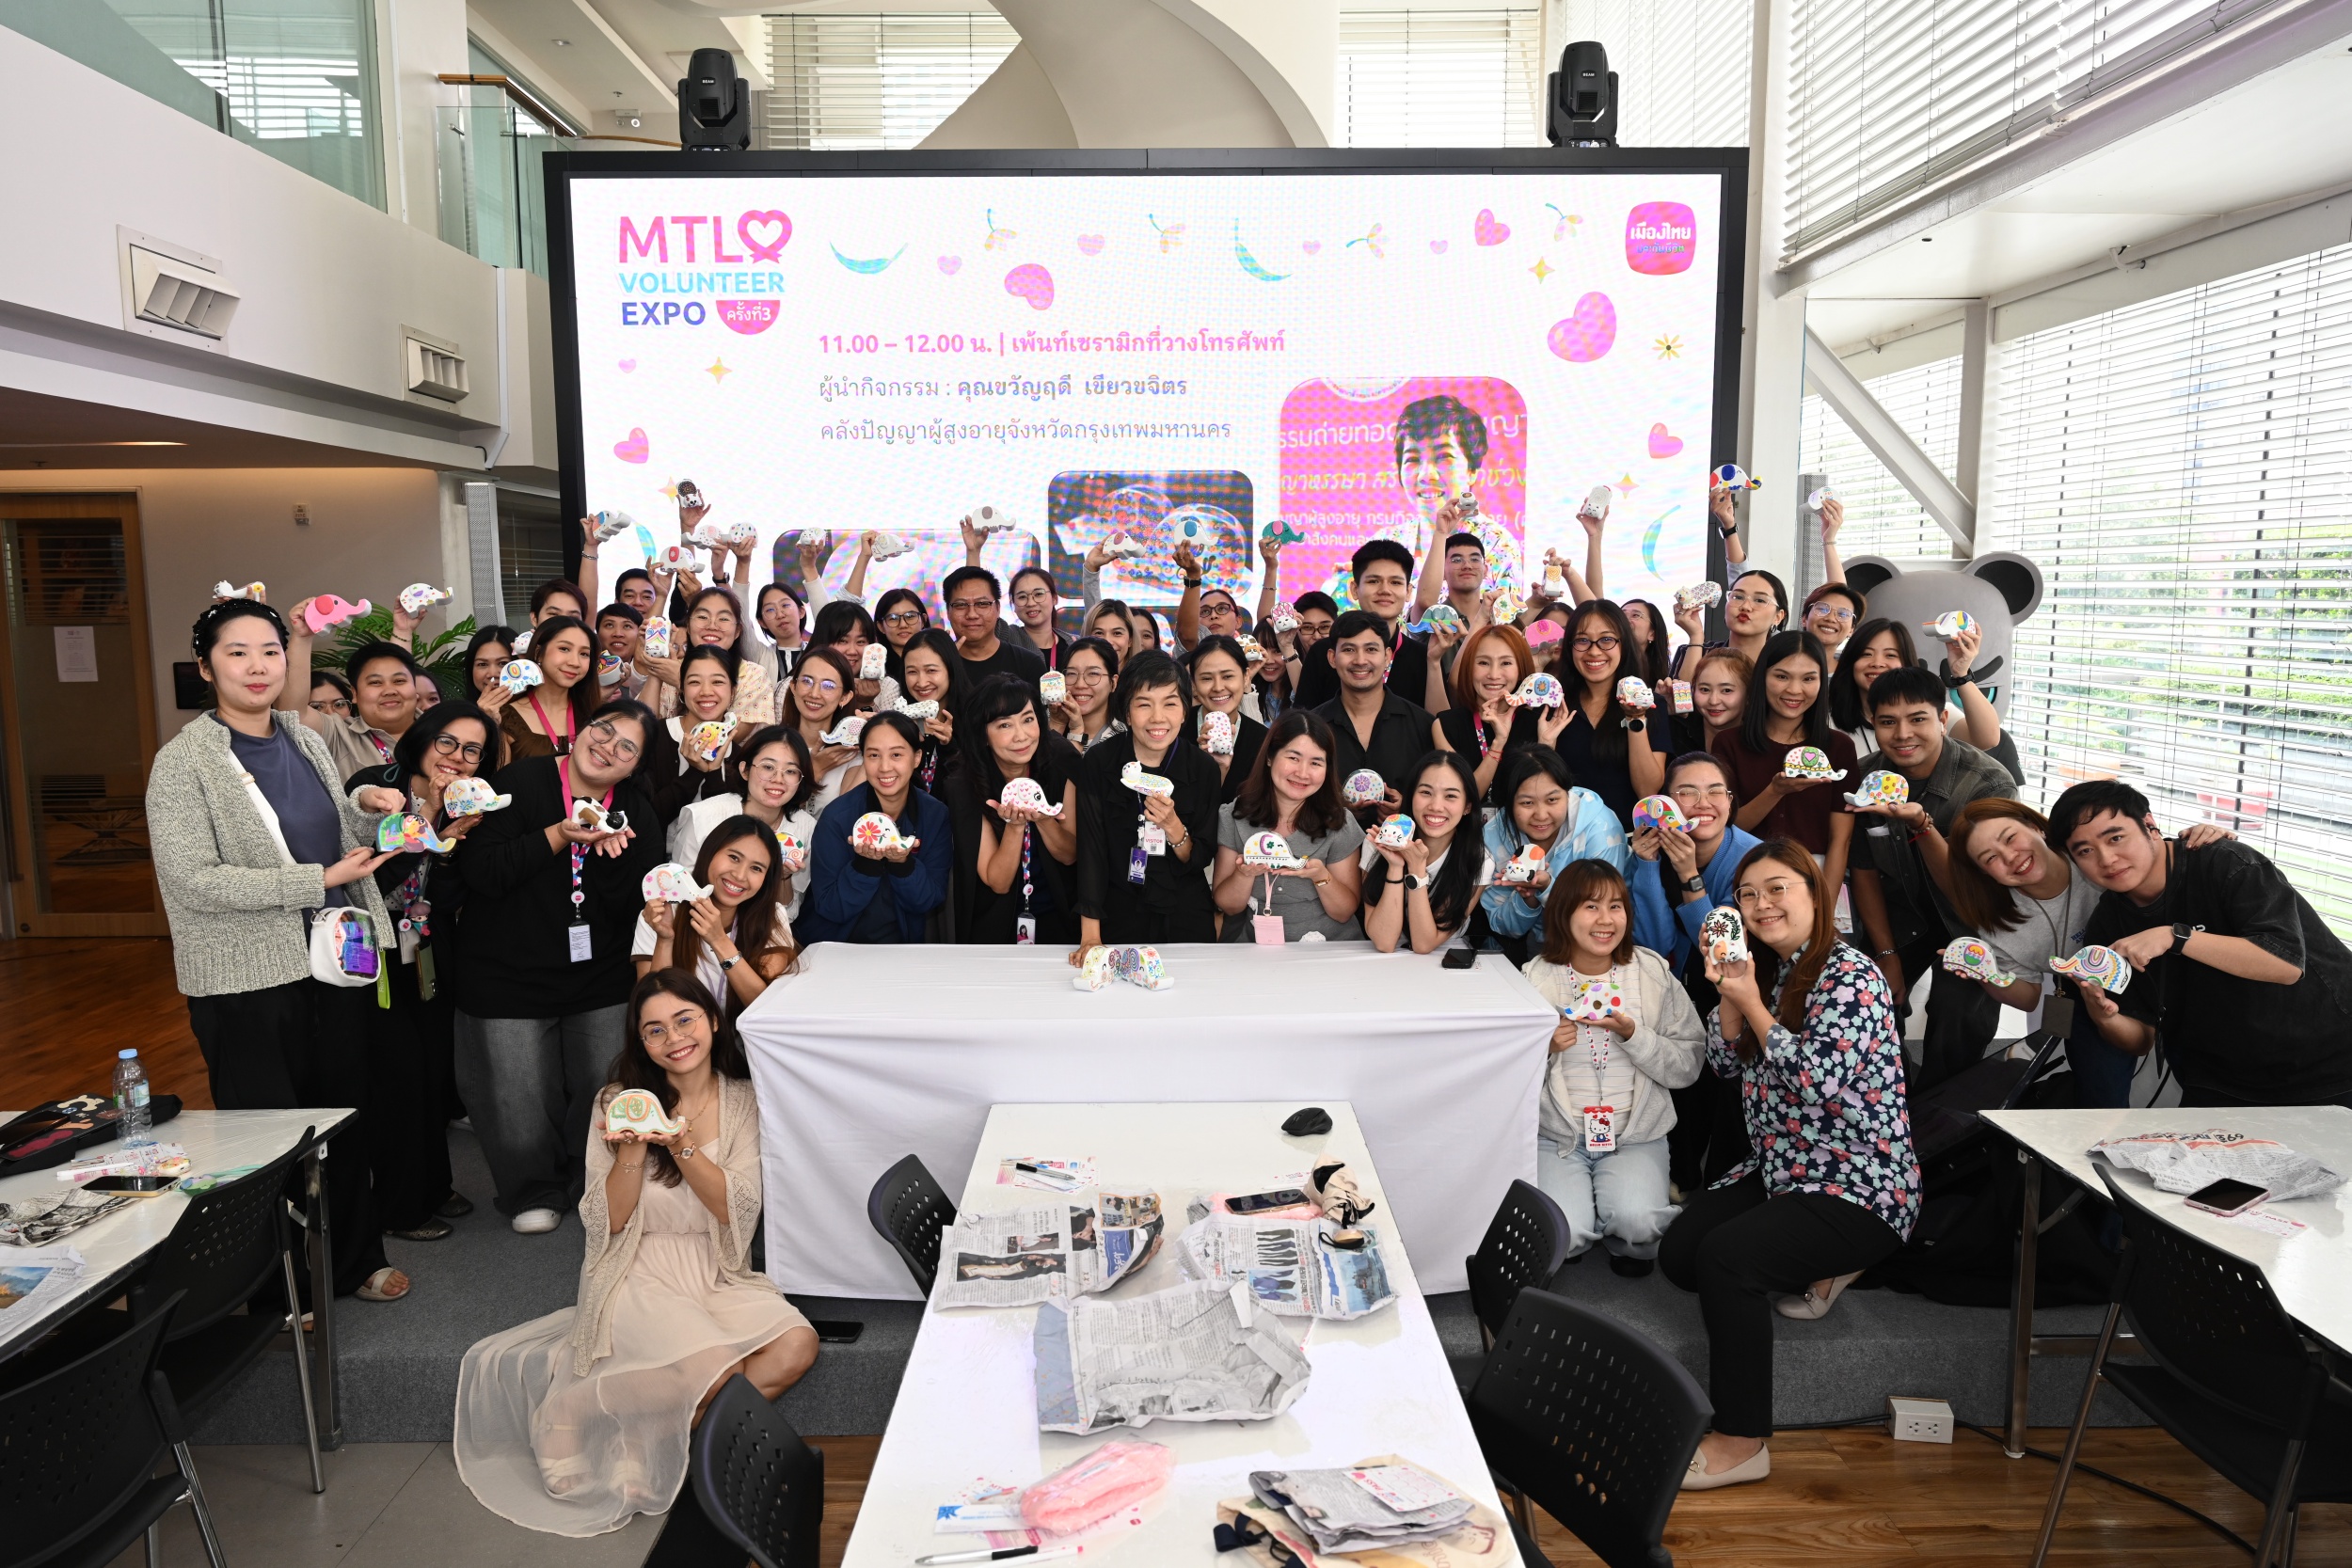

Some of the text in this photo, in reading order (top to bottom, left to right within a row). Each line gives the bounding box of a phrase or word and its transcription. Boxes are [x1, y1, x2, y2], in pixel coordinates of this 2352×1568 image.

[1630, 220, 1692, 240] เมืองไทย
[618, 272, 786, 293] VOLUNTEER
[621, 301, 706, 326] EXPO
[726, 300, 772, 323] ครั้งที่3
[818, 333, 879, 354] 11.00
[904, 333, 964, 354] 12.00
[970, 336, 993, 353] น.
[1011, 325, 1286, 354] เพ้นท์เซรามิกที่วางโทรศัพท์
[818, 374, 939, 403] ผู้นำกิจกรรม
[958, 373, 1073, 403] คุณขวัญฤดี
[820, 417, 1232, 446] คลังปัญญาผู้สูงอายุจังหวัดกรุงเทพมหานคร
